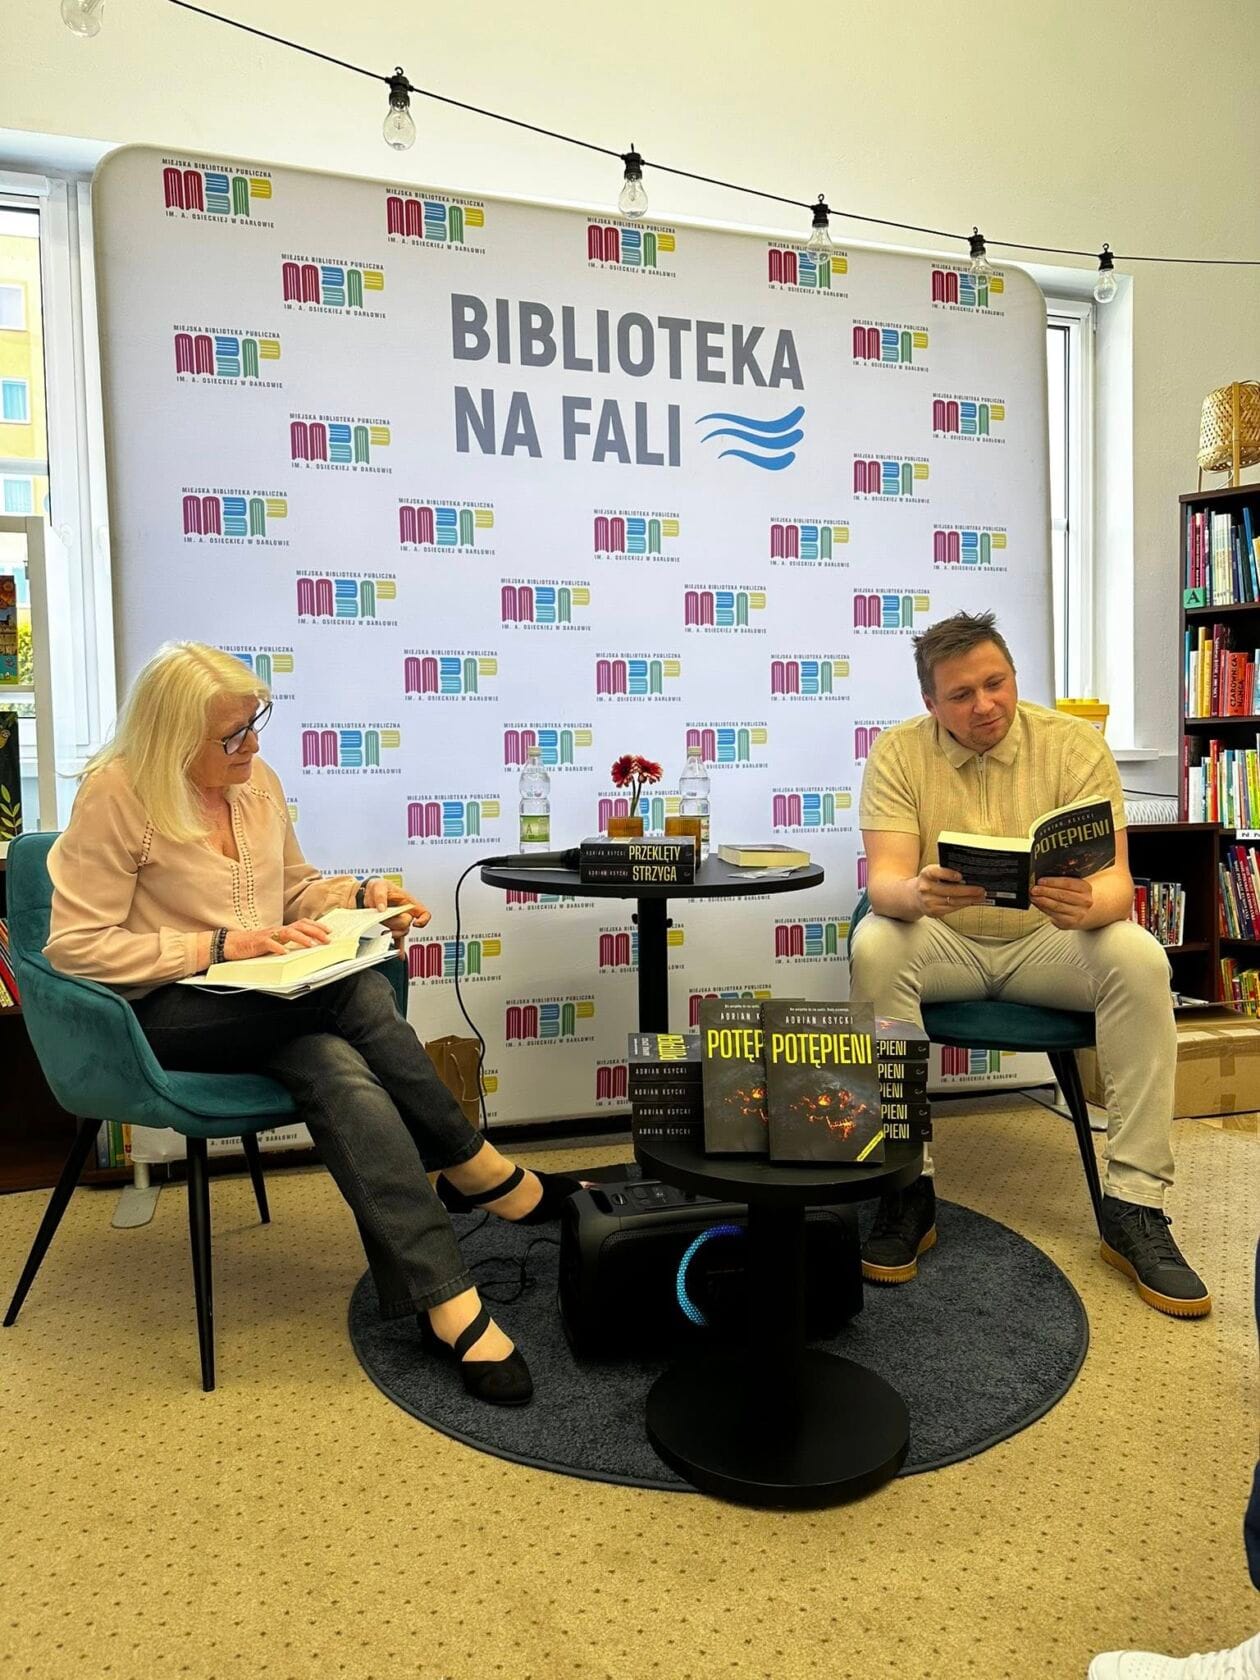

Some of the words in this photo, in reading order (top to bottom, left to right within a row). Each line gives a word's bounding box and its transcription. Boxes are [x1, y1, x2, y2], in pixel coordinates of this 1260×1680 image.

[162, 158, 191, 168] MIEJSKA
[194, 162, 233, 173] BIBLIOTEKA
[235, 167, 271, 178] PUBLICZNA
[386, 187, 412, 197] MIEJSKA
[414, 191, 450, 202] BIBLIOTEKA
[452, 197, 484, 208] PUBLICZNA
[192, 213, 228, 223] OSIECKIEJ
[411, 239, 444, 249] OSIECKIEJ
[281, 253, 308, 262] MIEJSKA
[311, 256, 348, 266] BIBLIOTEKA
[350, 260, 384, 270] PUBLICZNA
[308, 306, 342, 314] OSIECKIEJ
[173, 324, 202, 332] MIEJSKA
[204, 326, 243, 335] BIBLIOTEKA
[245, 329, 280, 338] PUBLICZNA
[451, 293, 804, 391] BIBLIOTEKA
[202, 377, 237, 385] OSIECKIEJ
[455, 386, 543, 458] NA
[563, 396, 681, 467] FALI
[1187, 590, 1200, 604] A
[1034, 818, 1110, 860] POTĘPIENI
[628, 846, 680, 862] PRZEKLĘTY
[632, 866, 677, 882] STRZYGA
[785, 1016, 817, 1024] ADRIAN
[822, 1016, 854, 1024] KSYCKI
[708, 1030, 763, 1063] POTĘP
[772, 1033, 872, 1068] POTĘPIENI
[877, 1040, 907, 1056] PIENI
[878, 1063, 904, 1079] PIENI
[880, 1104, 907, 1120] PIENI
[883, 1123, 910, 1139] PIENI
